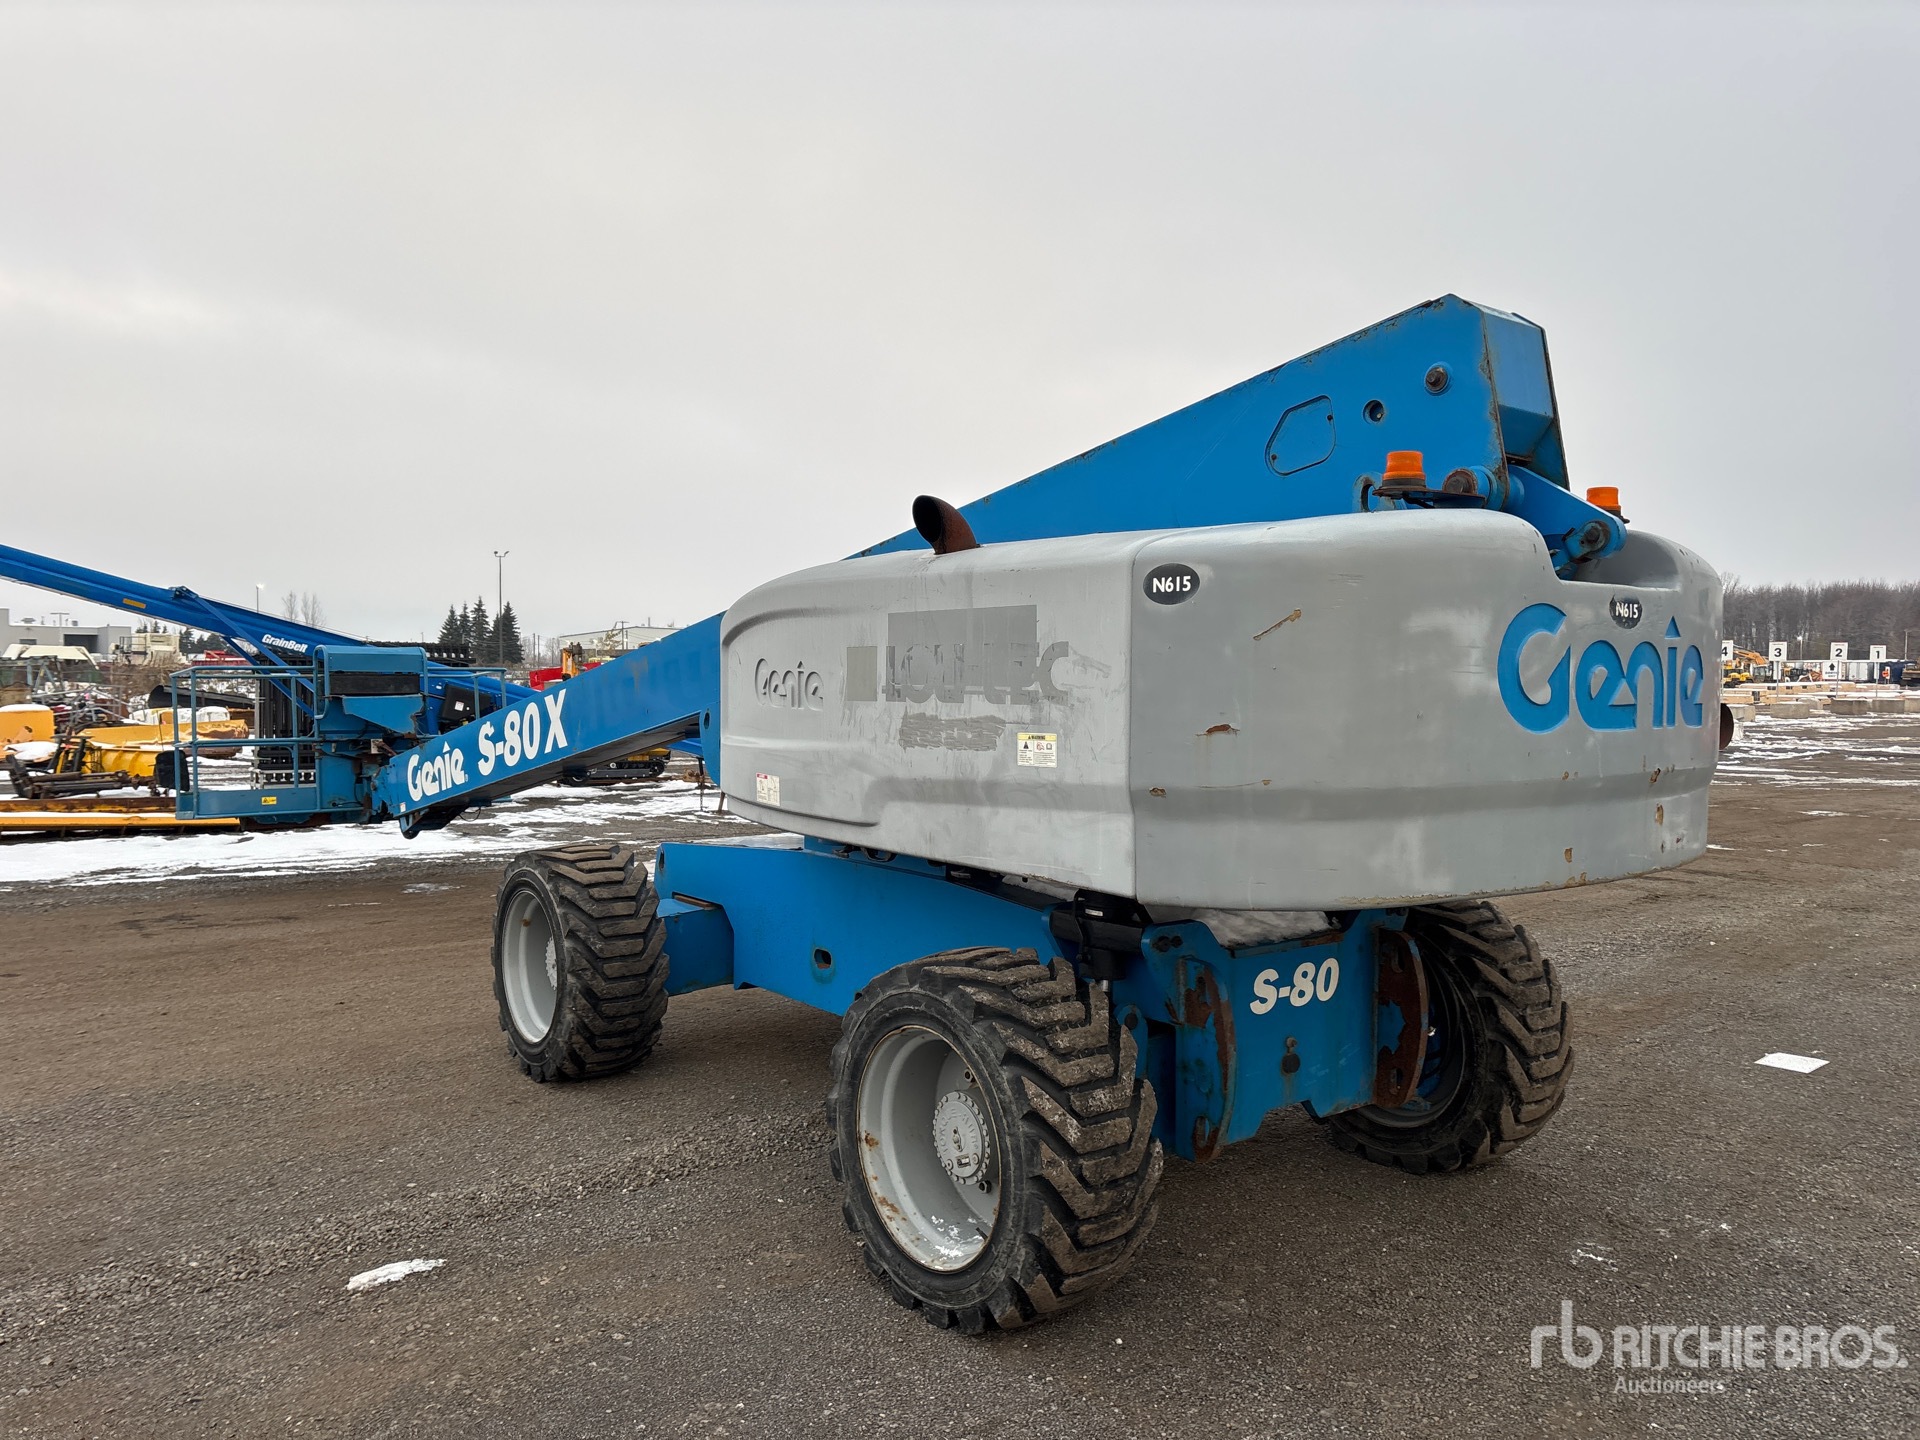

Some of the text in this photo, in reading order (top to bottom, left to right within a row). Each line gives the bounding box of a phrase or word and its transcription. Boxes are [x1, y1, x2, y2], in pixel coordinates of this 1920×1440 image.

[1153, 576, 1191, 593] N615
[1615, 602, 1639, 619] N615
[1721, 646, 1728, 657] 4
[1774, 647, 1782, 657] 3
[1835, 648, 1843, 657] 2
[1875, 650, 1880, 659] 1
[1497, 602, 1704, 735] Genie
[755, 658, 825, 711] Genie
[407, 741, 466, 801] Genie
[1249, 958, 1340, 1015] S-80
